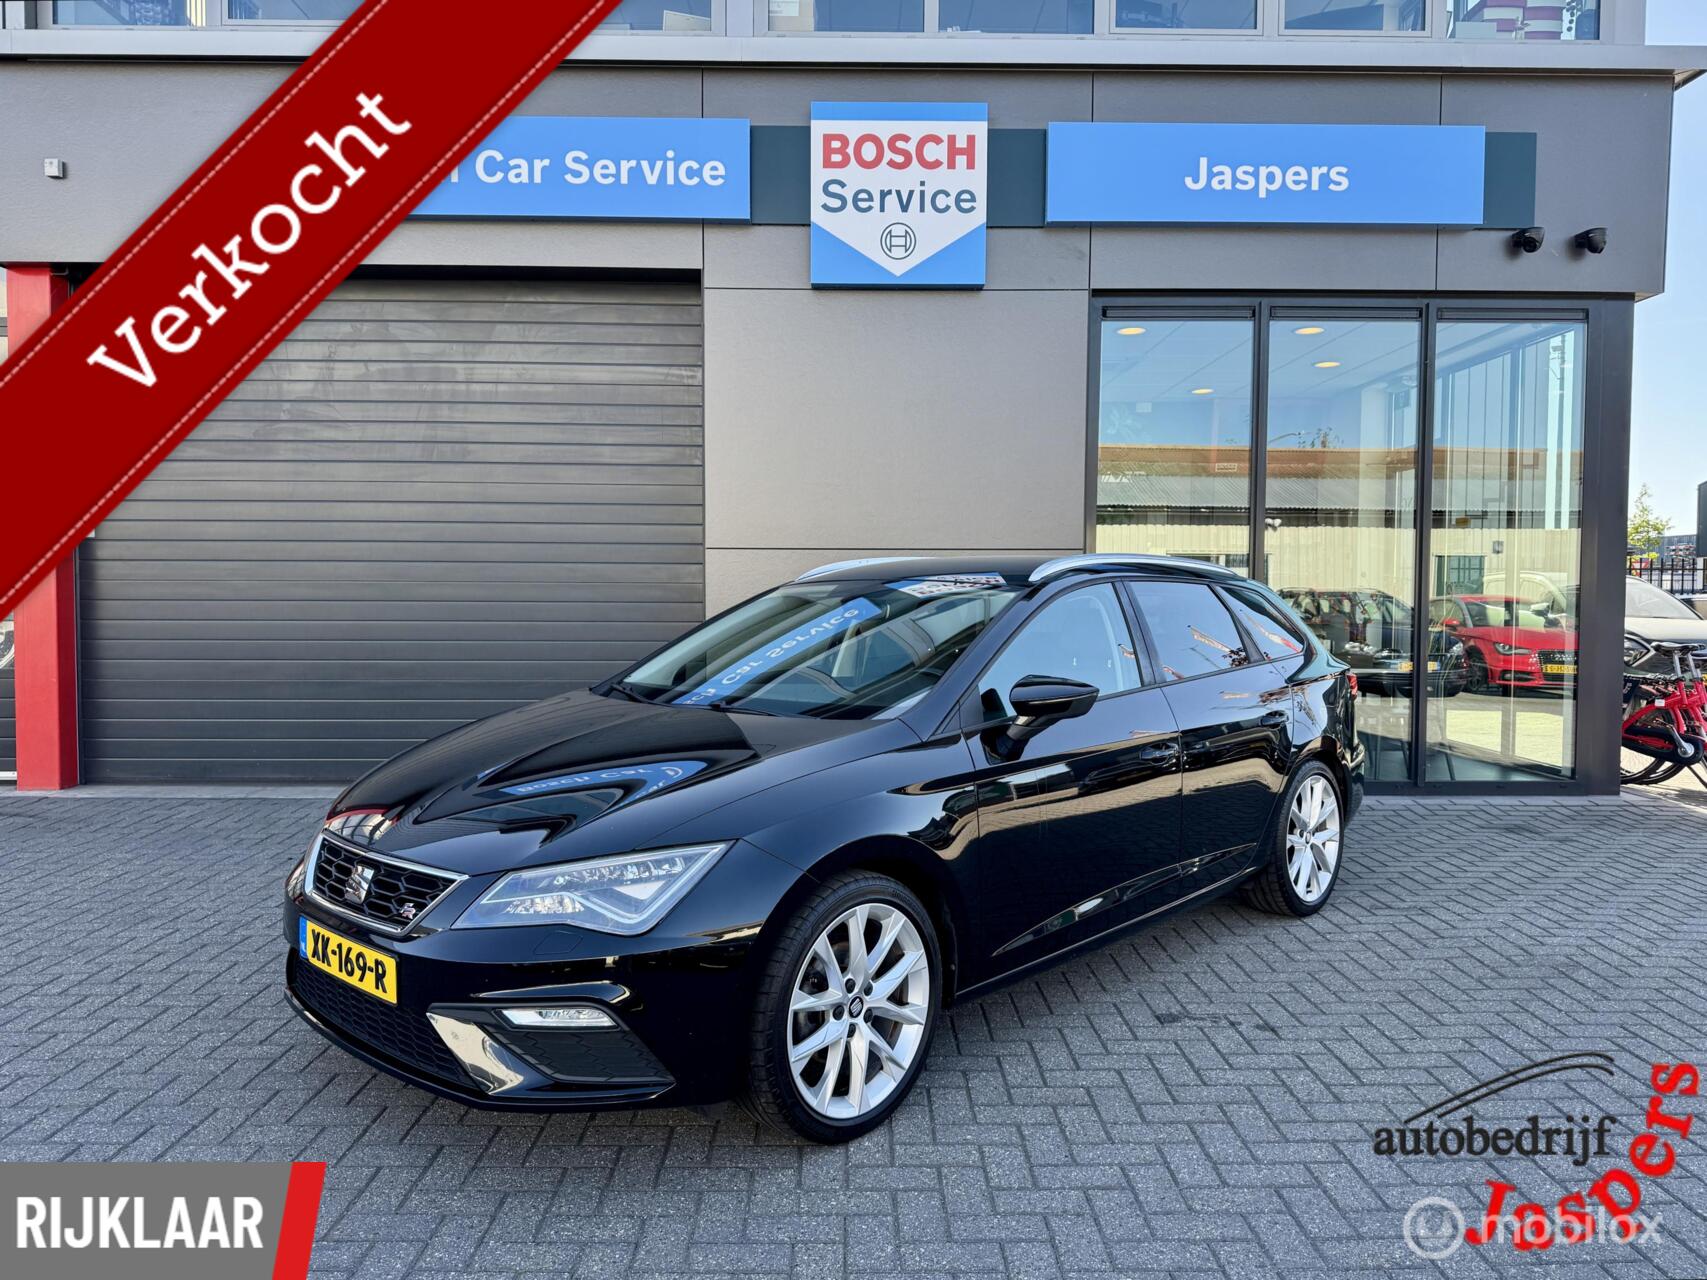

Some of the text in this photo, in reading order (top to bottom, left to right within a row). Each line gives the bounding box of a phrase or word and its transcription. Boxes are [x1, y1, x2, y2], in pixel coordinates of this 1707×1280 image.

[475, 149, 550, 184] Car
[564, 149, 726, 187] Service
[822, 133, 976, 170] BOSCH
[821, 179, 977, 214] Service
[1184, 156, 1350, 199] Jaspers
[311, 928, 387, 994] XK-169-R
